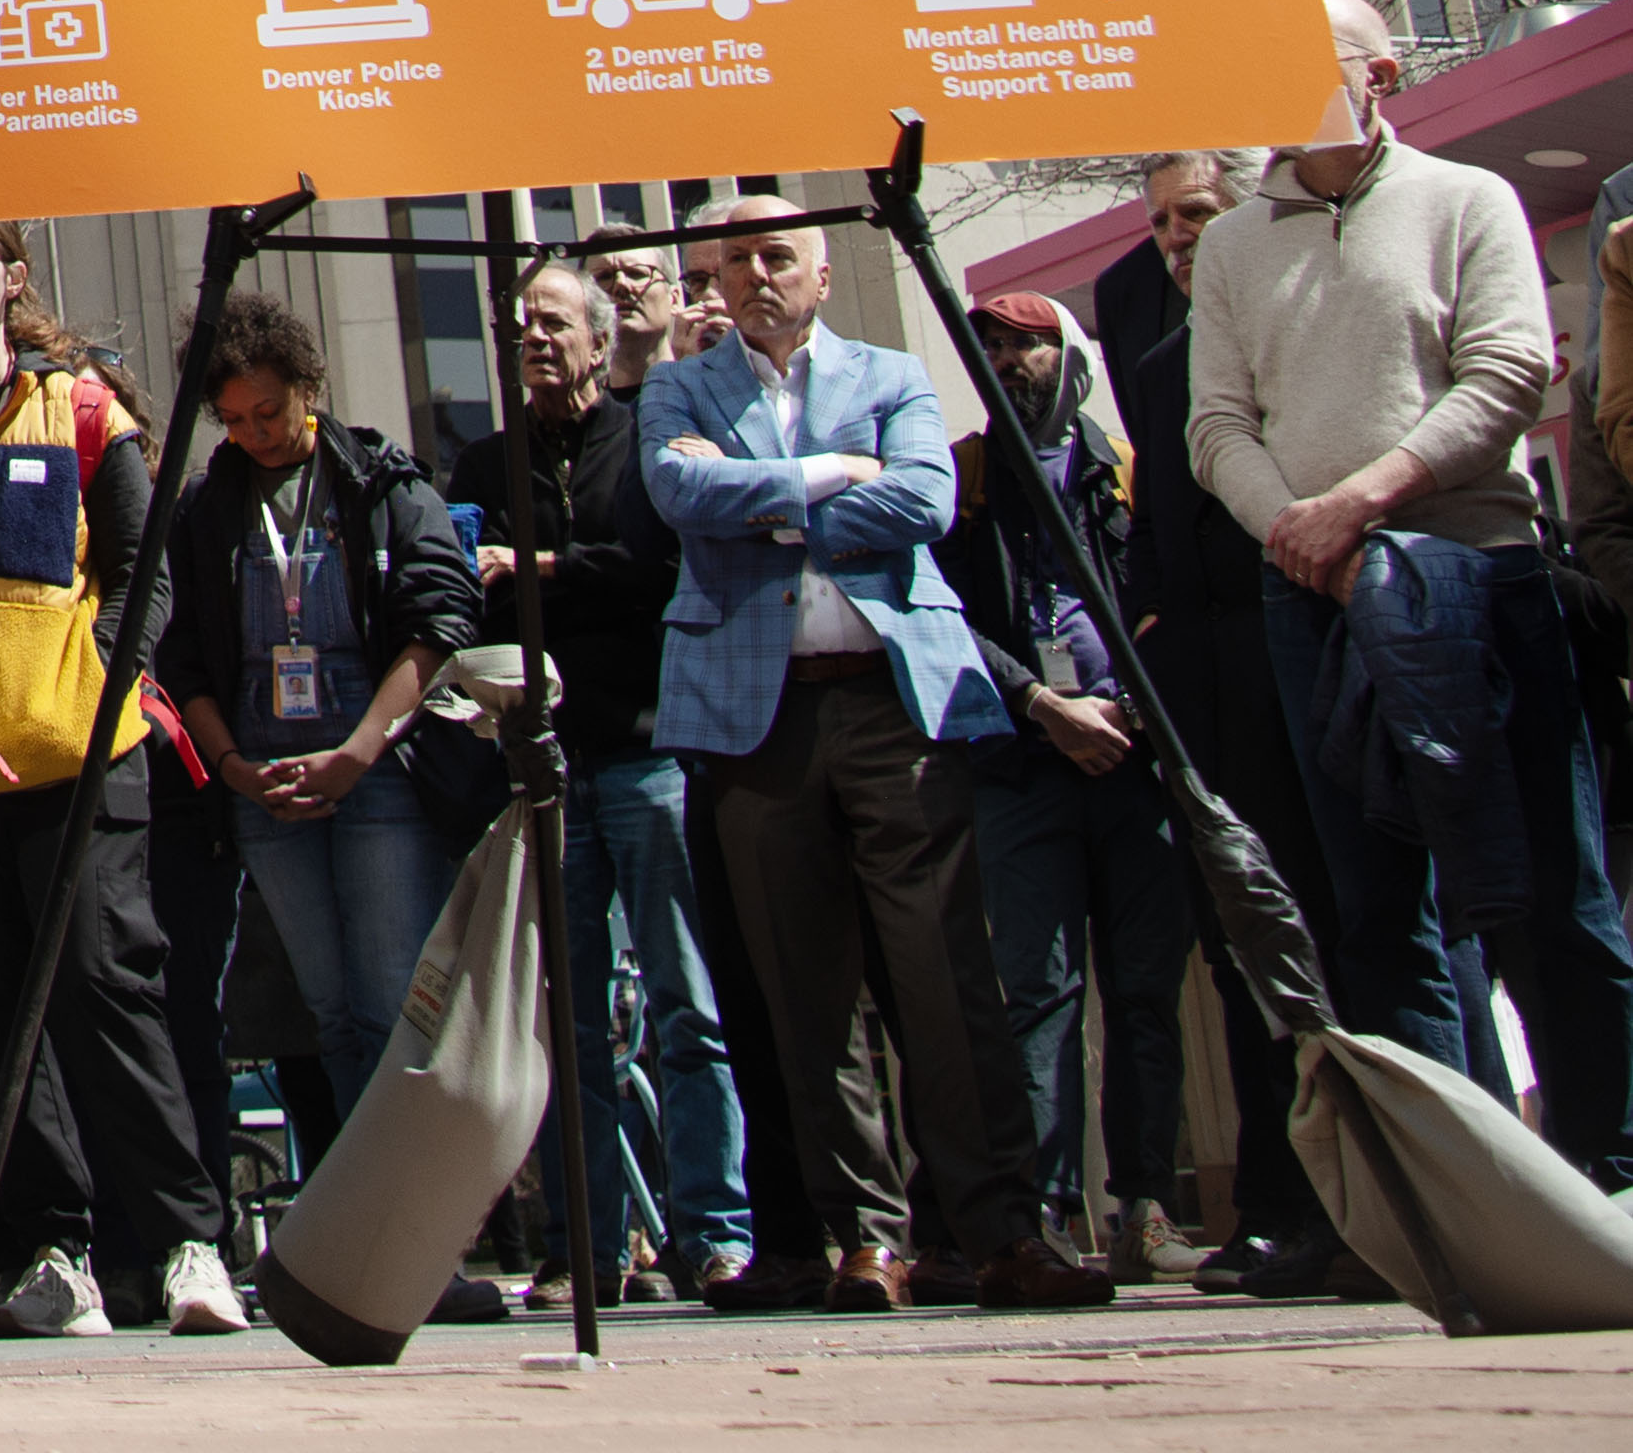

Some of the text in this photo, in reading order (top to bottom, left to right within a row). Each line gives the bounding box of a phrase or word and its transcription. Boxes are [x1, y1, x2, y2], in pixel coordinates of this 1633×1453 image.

[903, 14, 1157, 50] Mental Health and
[586, 39, 765, 70] 2 Denver Fire
[931, 42, 1136, 74] Substance Use
[262, 59, 443, 90] Denver Police
[586, 63, 773, 94] Medical Units
[942, 70, 1134, 101] Support Team
[34, 80, 119, 106] Health
[318, 86, 393, 111] Kiosk
